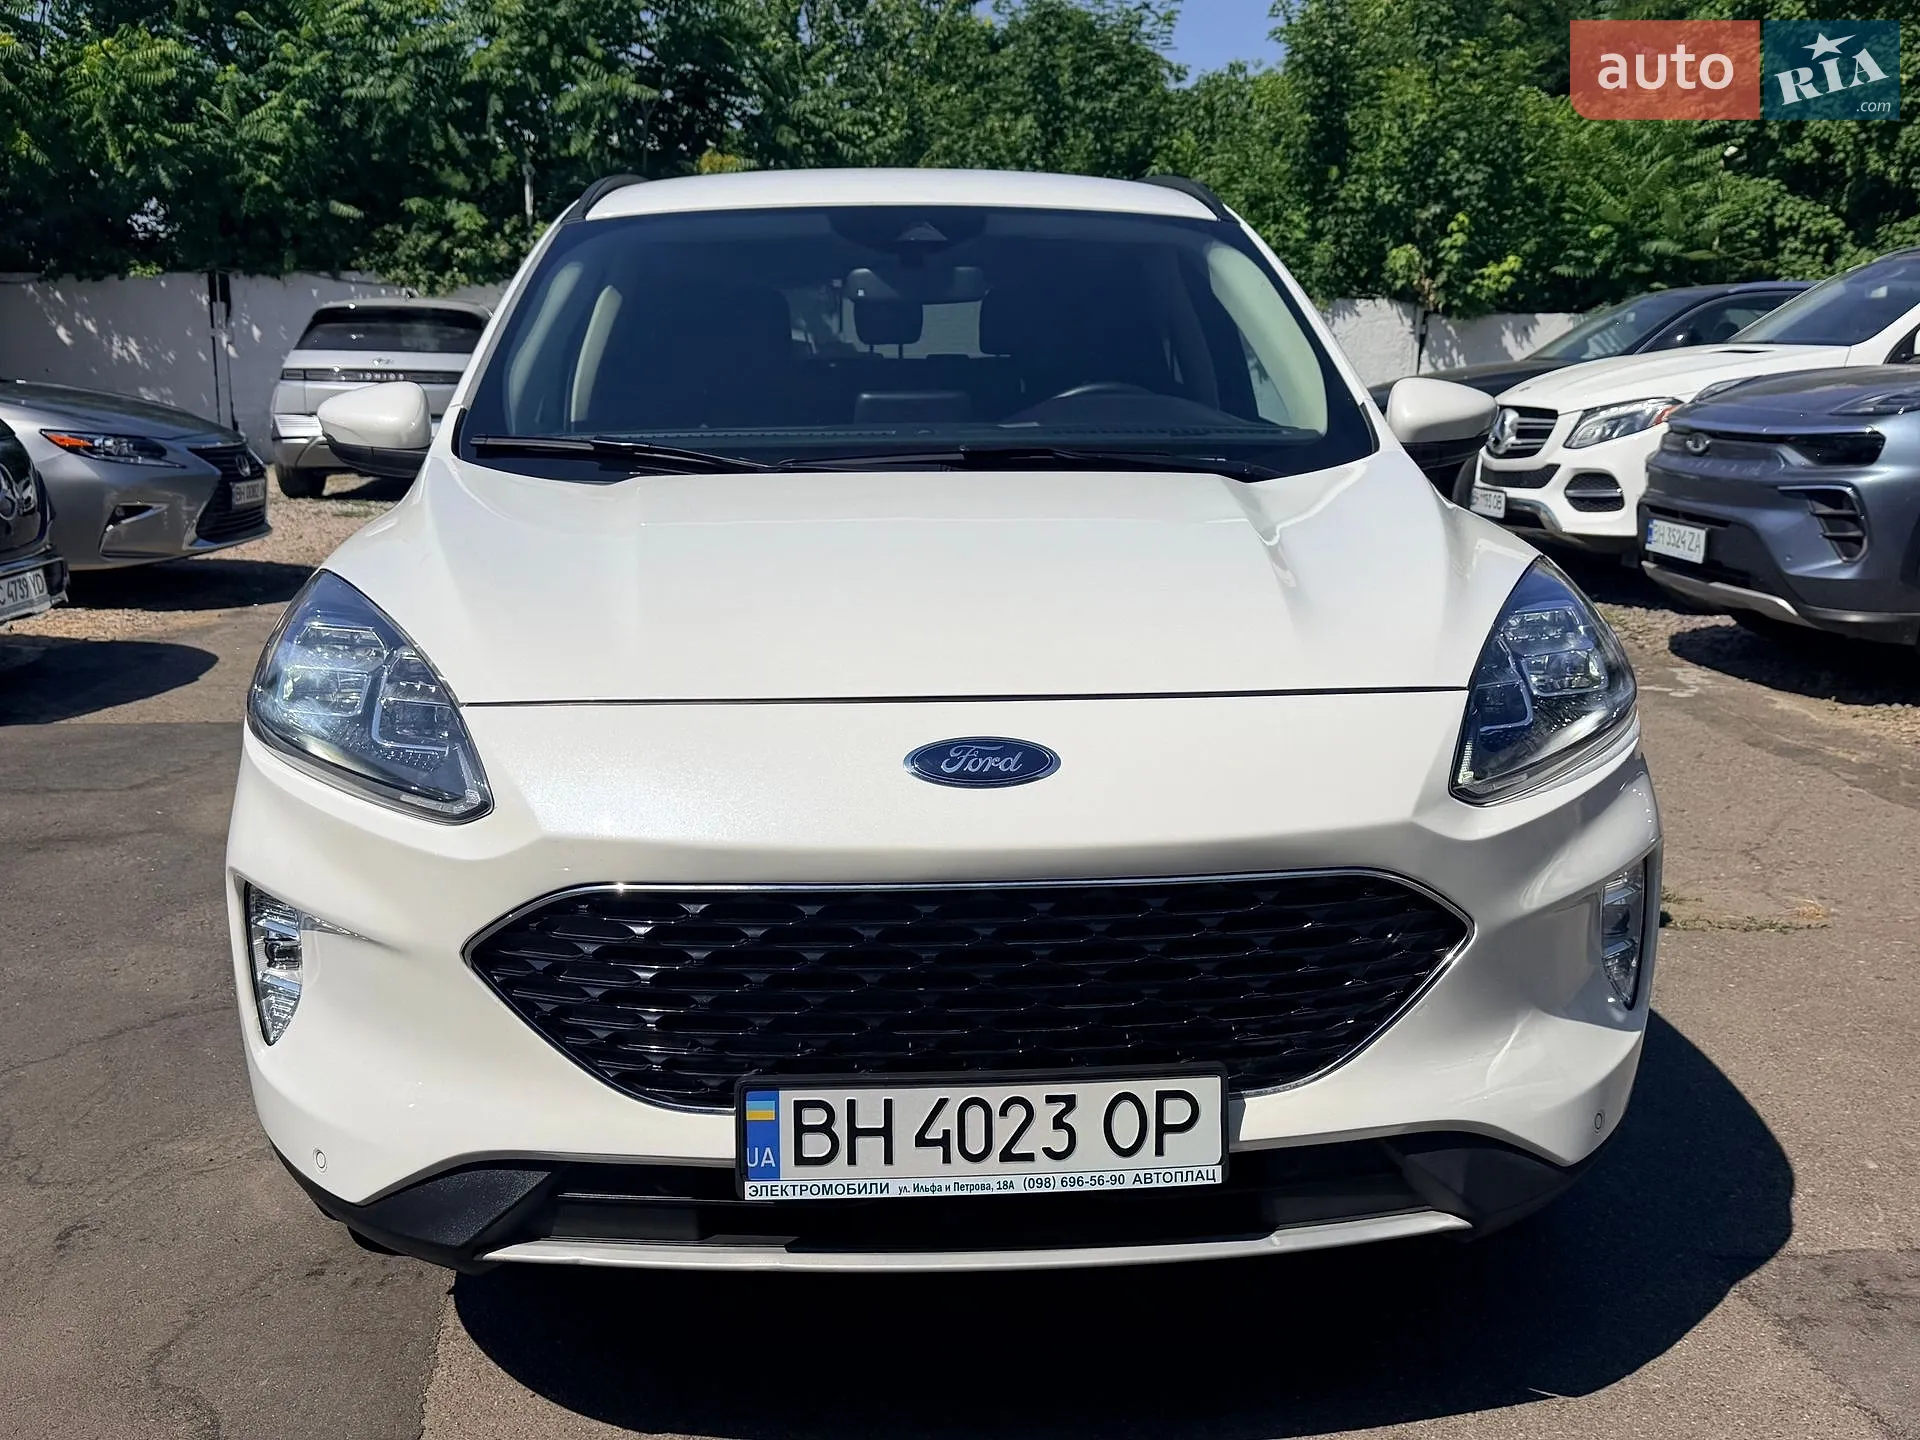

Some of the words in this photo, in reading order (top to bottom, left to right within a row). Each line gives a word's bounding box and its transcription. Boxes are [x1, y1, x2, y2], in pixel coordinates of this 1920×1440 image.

[7, 576, 29, 602] 4739
[941, 745, 1023, 774] Ford
[793, 1098, 894, 1167] BH
[914, 1093, 1077, 1164] 4023
[1103, 1089, 1200, 1160] OP
[746, 1147, 776, 1168] UA
[748, 1181, 890, 1198] ЭЛЕКТРОМОБИЛИ
[898, 1185, 911, 1195] ул.
[913, 1182, 943, 1194] Ильфа
[944, 1183, 951, 1192] и
[953, 1180, 994, 1193] Петрова,
[1023, 1176, 1056, 1192] (098)
[1060, 1173, 1126, 1188] 696-56-90
[1132, 1168, 1217, 1186] АВТОПЛАЦ
